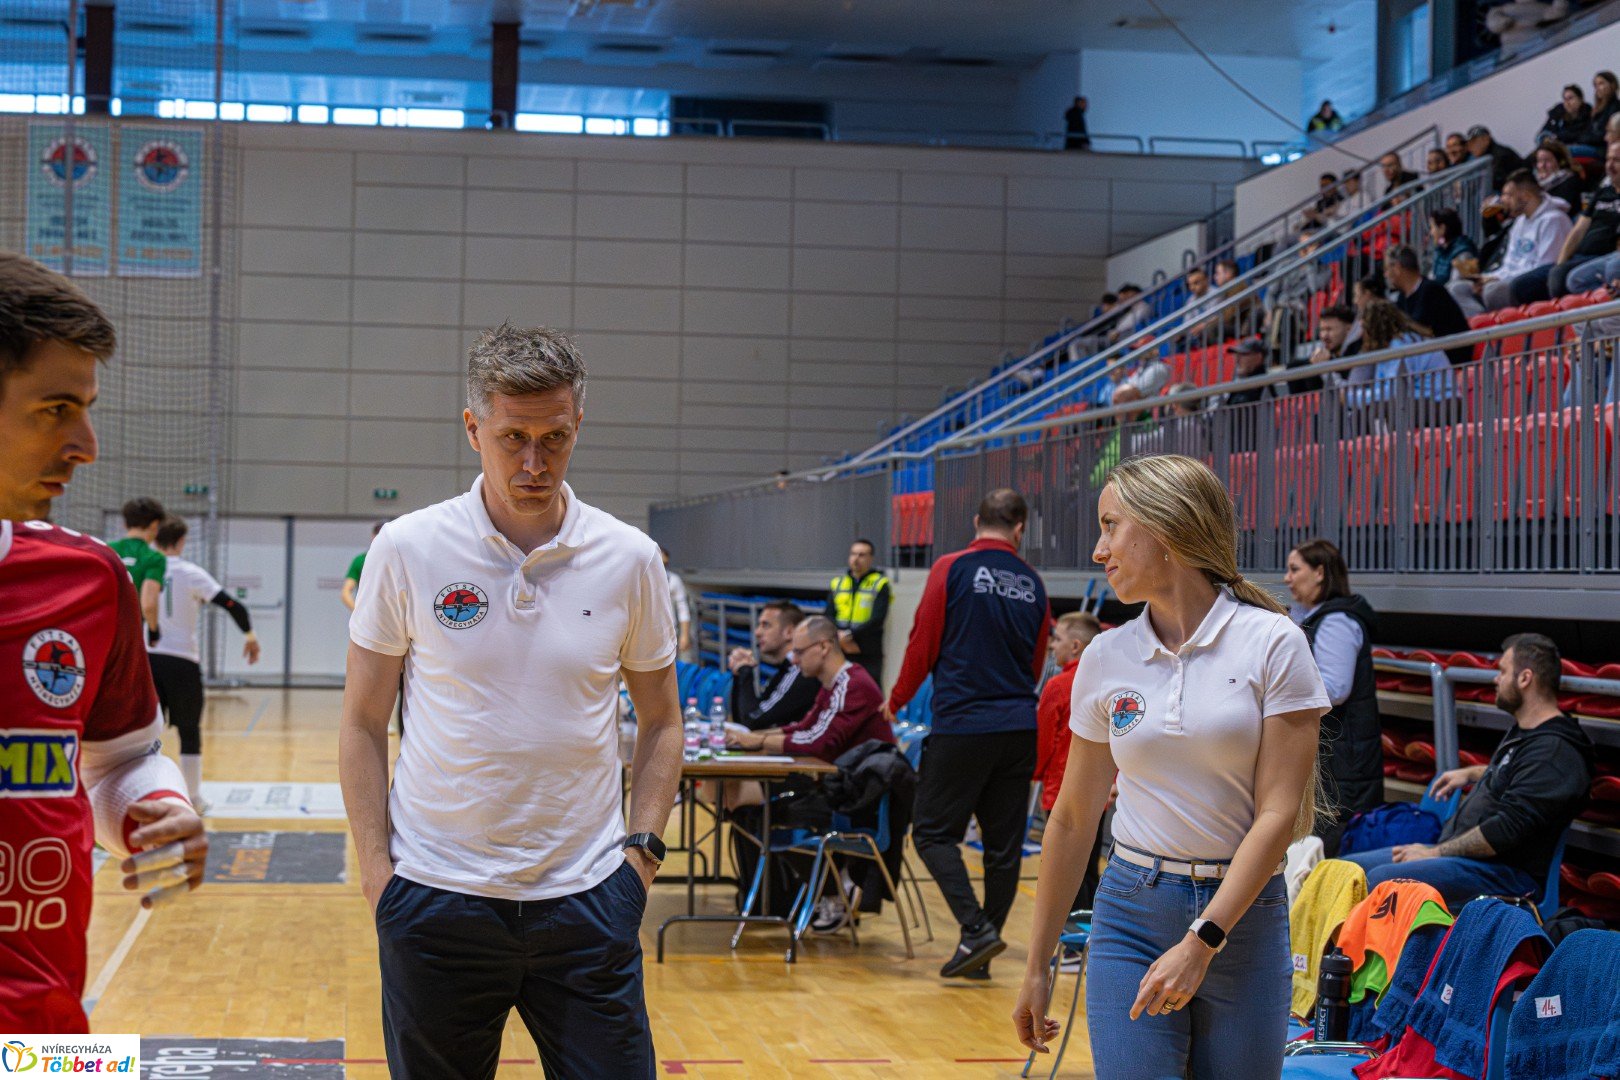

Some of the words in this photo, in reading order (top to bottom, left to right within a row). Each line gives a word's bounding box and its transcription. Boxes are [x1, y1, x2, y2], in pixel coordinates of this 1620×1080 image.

[440, 584, 481, 598] FUTSAL
[973, 581, 1037, 604] STUDIO
[1317, 1007, 1328, 1042] RESPECT
